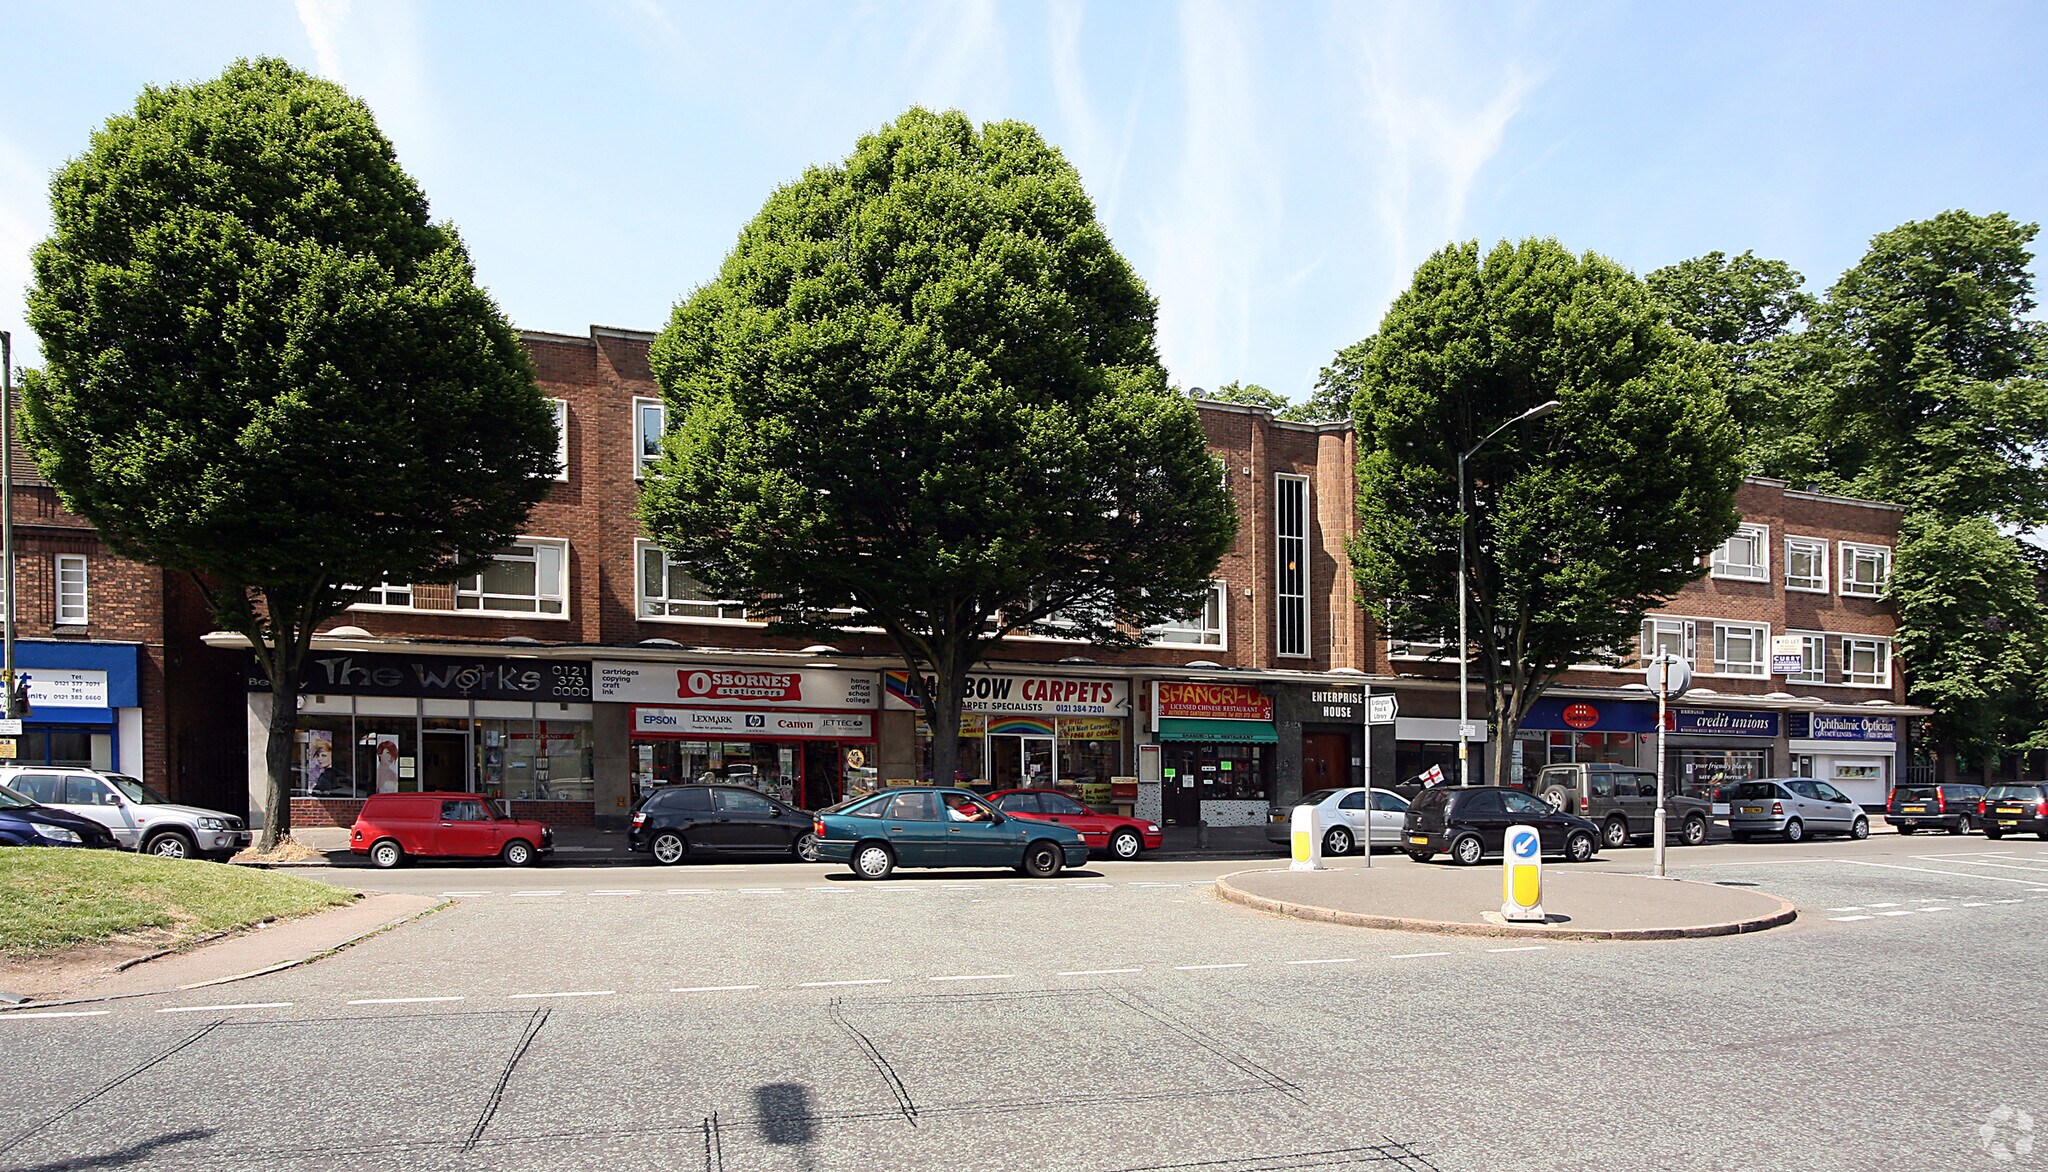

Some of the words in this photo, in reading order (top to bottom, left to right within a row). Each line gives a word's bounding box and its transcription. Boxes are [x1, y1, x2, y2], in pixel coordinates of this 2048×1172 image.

[315, 657, 403, 686] The
[411, 664, 541, 692] Works
[552, 665, 587, 675] 0121
[558, 676, 584, 686] 373
[688, 672, 791, 694] OSBORNES
[552, 687, 589, 696] 0000
[722, 688, 781, 696] stationers
[1022, 679, 1113, 703] CARPETS
[1159, 684, 1269, 706] SHANGRI-LA
[1312, 691, 1363, 704] ENTERPRISE
[992, 702, 1043, 711] SPECIALISTS
[1056, 704, 1071, 712] 0121
[1073, 705, 1086, 713] 384
[1088, 705, 1105, 713] 7201
[1170, 703, 1197, 711] LICENSED
[1323, 706, 1352, 717] HOUSE
[644, 716, 677, 724] EPSON
[692, 714, 732, 724] LEXMARK
[777, 719, 814, 729] Canon
[1697, 712, 1729, 727] credit
[1732, 714, 1769, 729] unions
[1814, 717, 1860, 732] Ophthalmic
[1861, 719, 1893, 733] Optician
